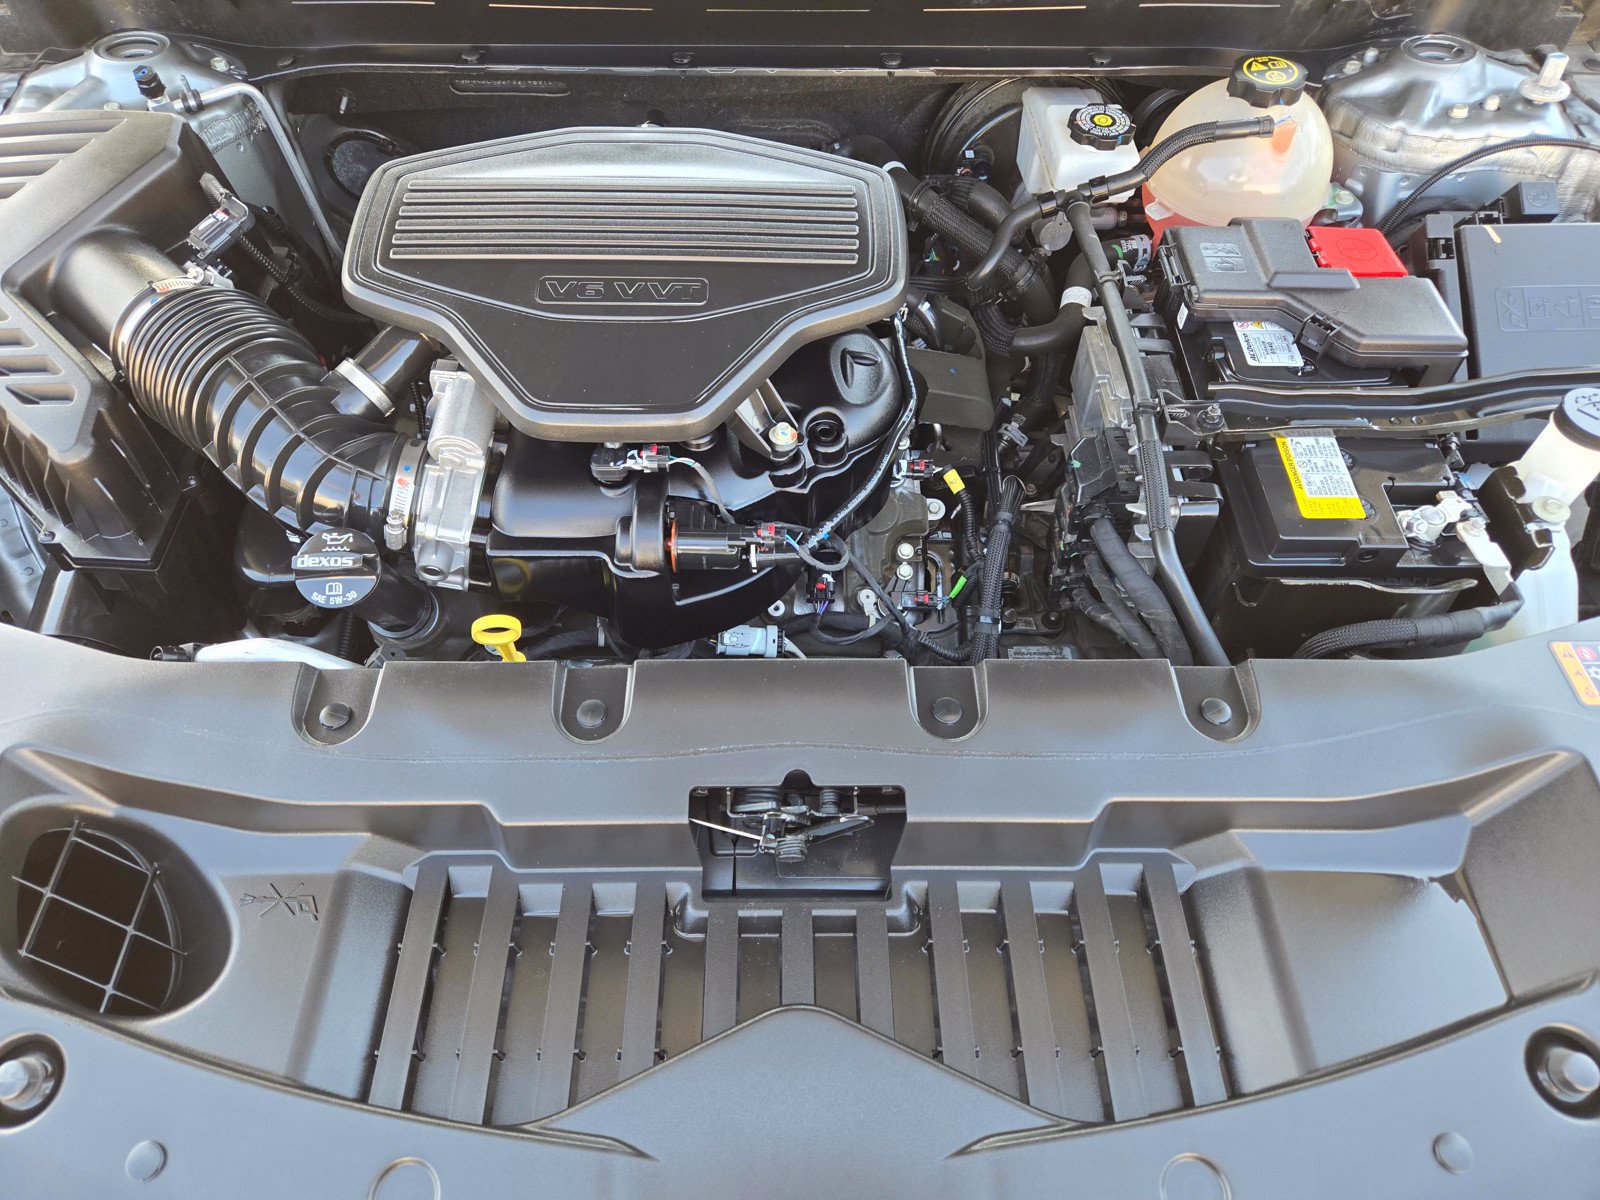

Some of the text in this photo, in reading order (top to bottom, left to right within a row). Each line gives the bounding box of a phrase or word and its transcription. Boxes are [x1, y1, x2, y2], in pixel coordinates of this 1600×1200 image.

[545, 281, 701, 299] V6 VVT
[296, 554, 356, 568] dexos
[311, 590, 358, 605] SAE 5W-30
